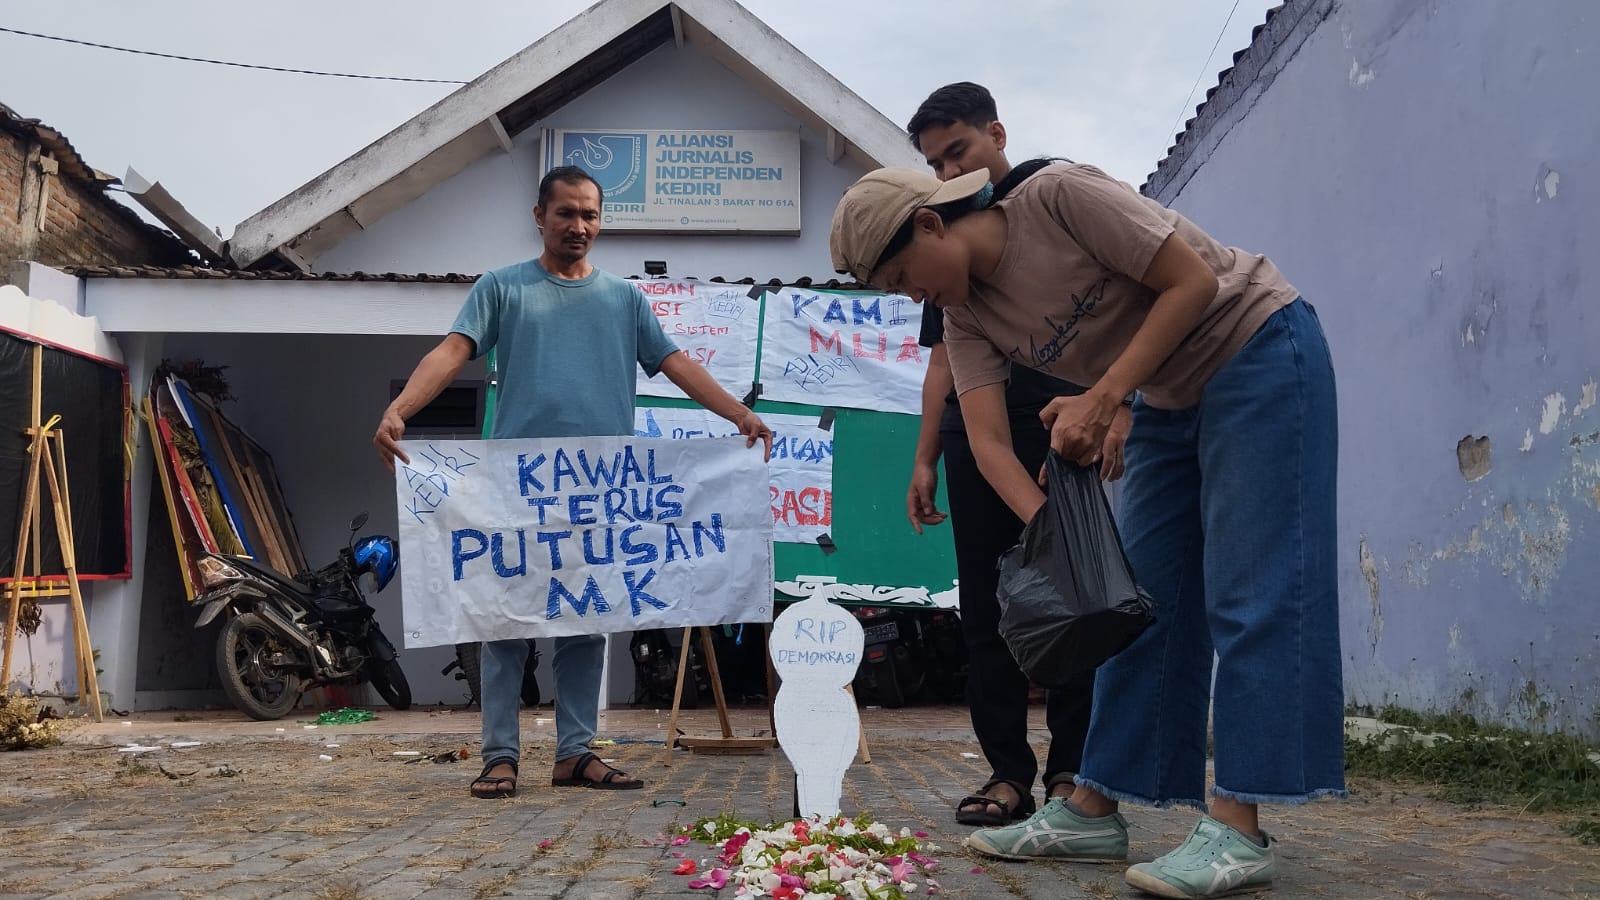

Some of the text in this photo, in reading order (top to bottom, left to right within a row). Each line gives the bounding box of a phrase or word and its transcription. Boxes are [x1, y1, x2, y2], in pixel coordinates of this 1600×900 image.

[655, 134, 733, 148] ALIANSI
[655, 151, 754, 164] JURNALIS
[655, 166, 783, 181] INDEPENDEN
[655, 182, 722, 196] KEDIRI
[603, 204, 645, 214] EDIRI
[653, 197, 665, 205] JL
[668, 198, 711, 206] TINALAN
[723, 199, 756, 207] BARAT
[791, 294, 907, 326] KAMI
[675, 323, 729, 336] SISTEM
[784, 354, 819, 376] AJI
[795, 354, 860, 392] KEDIRI
[402, 444, 448, 488] AJI
[517, 445, 673, 497] KAWAL
[405, 447, 480, 524] KEDIRI
[527, 485, 684, 525] TERUS
[451, 513, 726, 581] PUTUSAN
[545, 568, 669, 620] MK
[795, 617, 847, 643] RIP
[778, 650, 855, 665] DEMOKRASI
